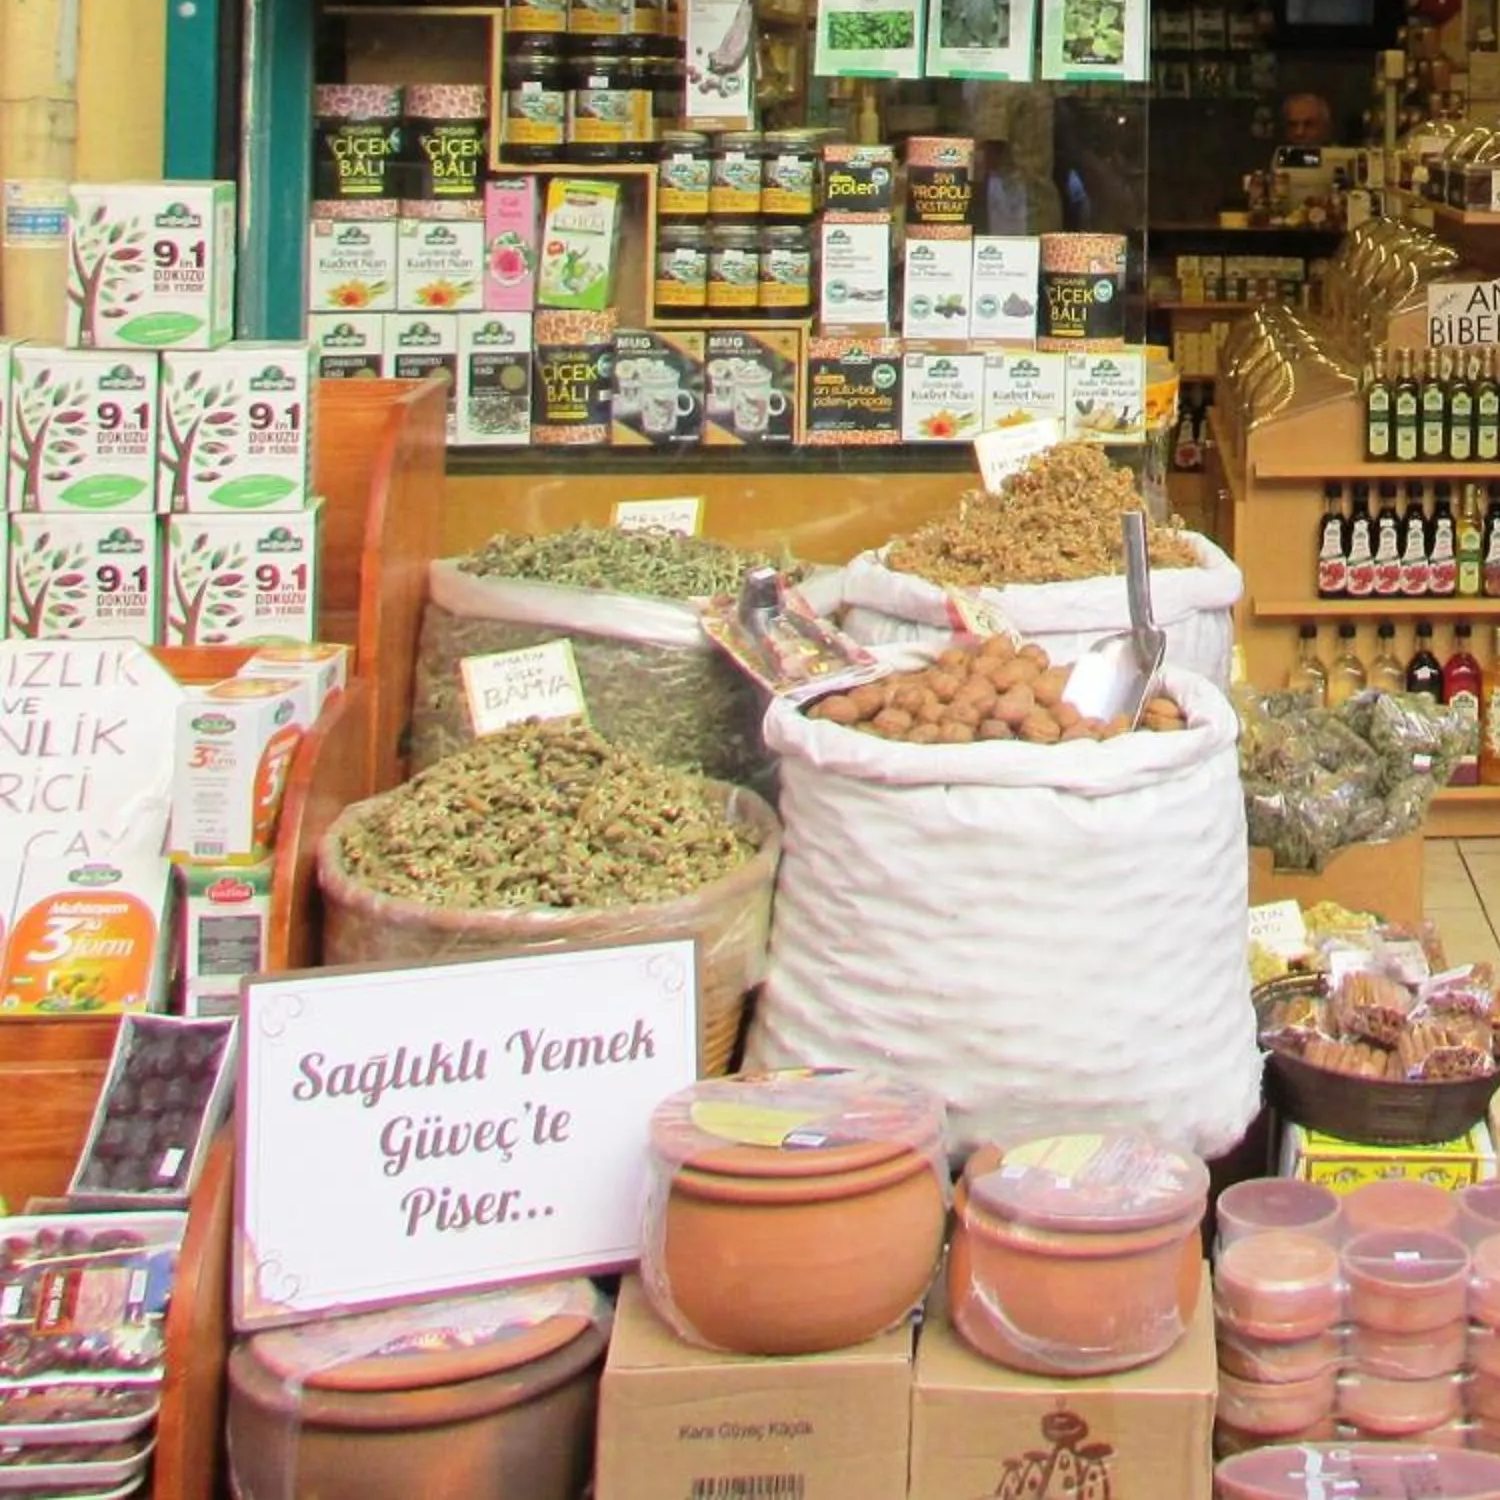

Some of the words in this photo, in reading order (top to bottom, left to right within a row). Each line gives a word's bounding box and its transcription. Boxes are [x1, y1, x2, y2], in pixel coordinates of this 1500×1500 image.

[828, 180, 880, 199] polen
[153, 240, 178, 268] 9
[189, 241, 205, 268] 1
[617, 336, 651, 348] MUG
[709, 336, 743, 348] MUG
[97, 402, 122, 430] 9
[133, 403, 149, 430] 1
[248, 402, 273, 430] 9
[285, 403, 300, 430] 1
[97, 565, 122, 592] 9
[132, 565, 148, 592] 1
[255, 563, 281, 591] 9
[292, 563, 307, 591] 1
[2, 696, 41, 715] VE
[292, 1038, 488, 1108] Sağlıklı
[504, 1018, 656, 1076] Yemek
[379, 1100, 572, 1178] Güveç'te
